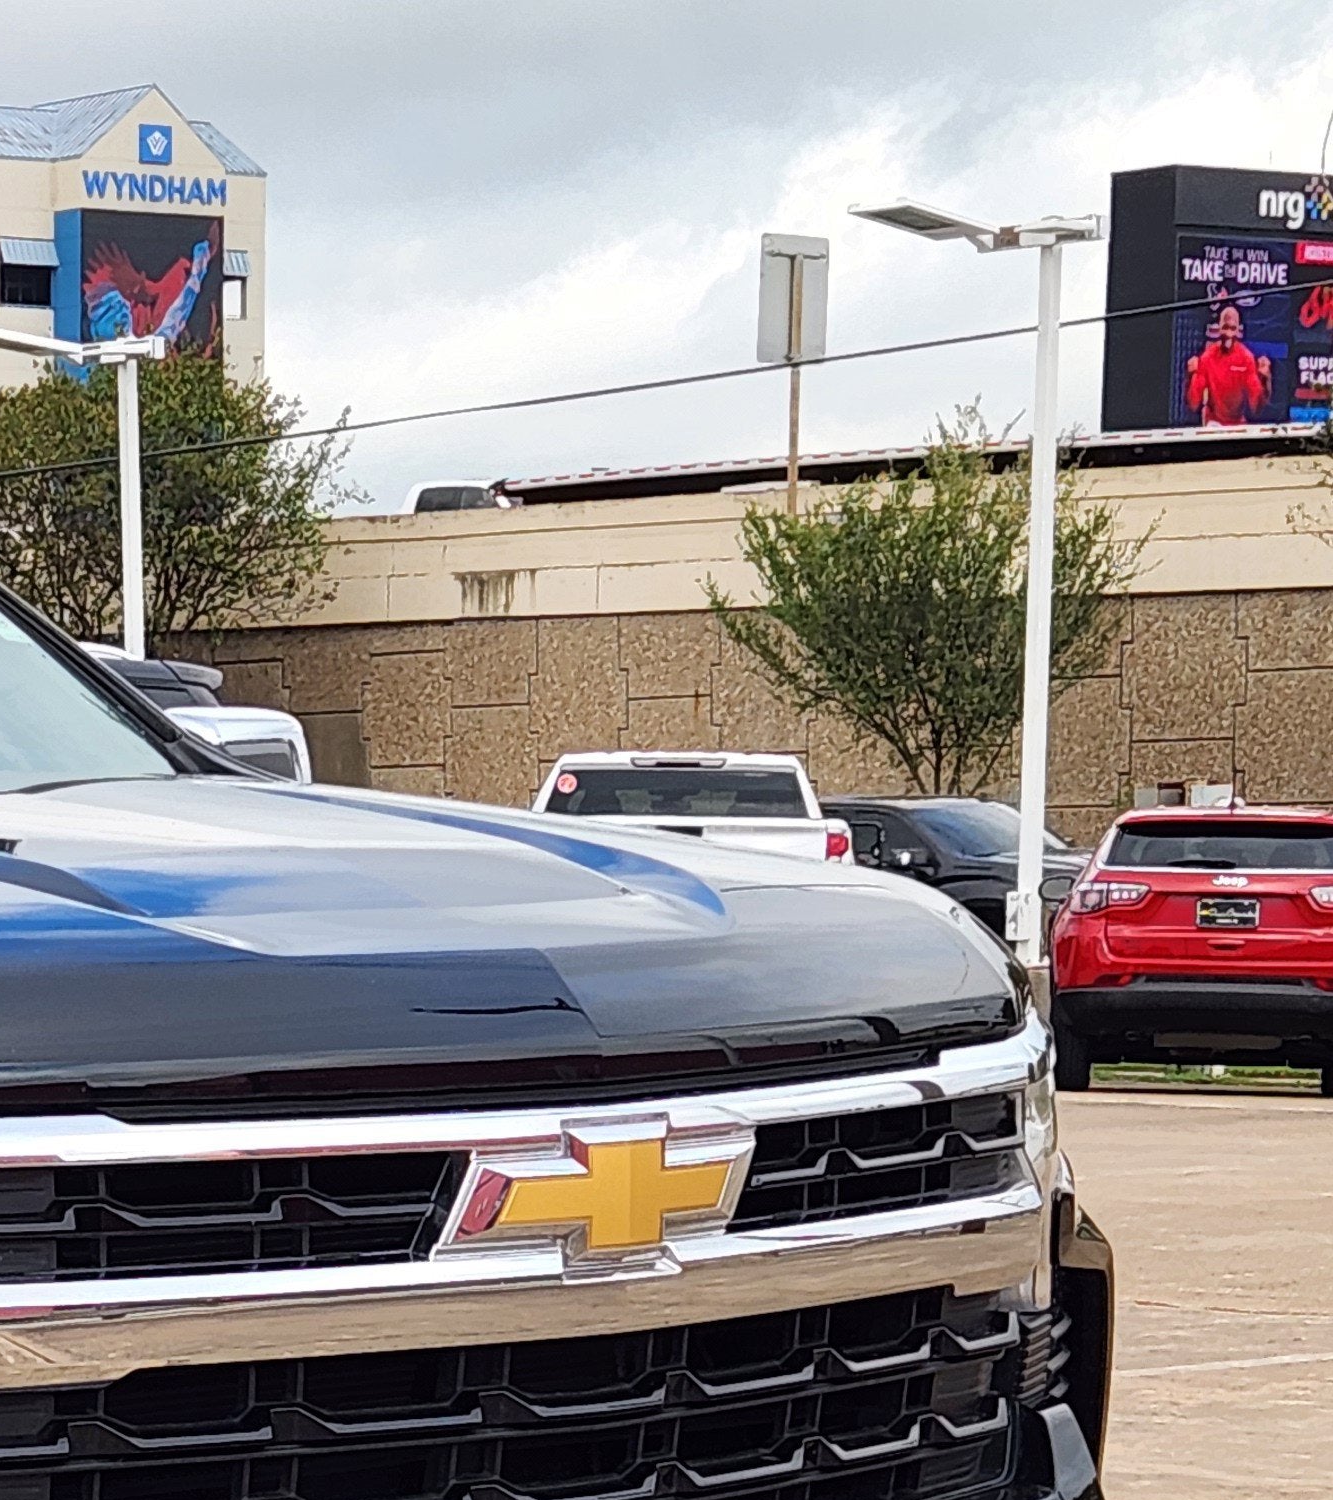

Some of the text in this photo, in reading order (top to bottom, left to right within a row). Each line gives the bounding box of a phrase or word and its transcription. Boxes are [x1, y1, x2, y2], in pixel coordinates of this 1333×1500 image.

[82, 169, 228, 206] WYNDHAM
[1259, 189, 1305, 230] nrg
[1203, 245, 1230, 261] TAKE
[1246, 249, 1270, 263] WIN
[1181, 258, 1225, 282] TAKE
[1237, 262, 1289, 285] DRIVE
